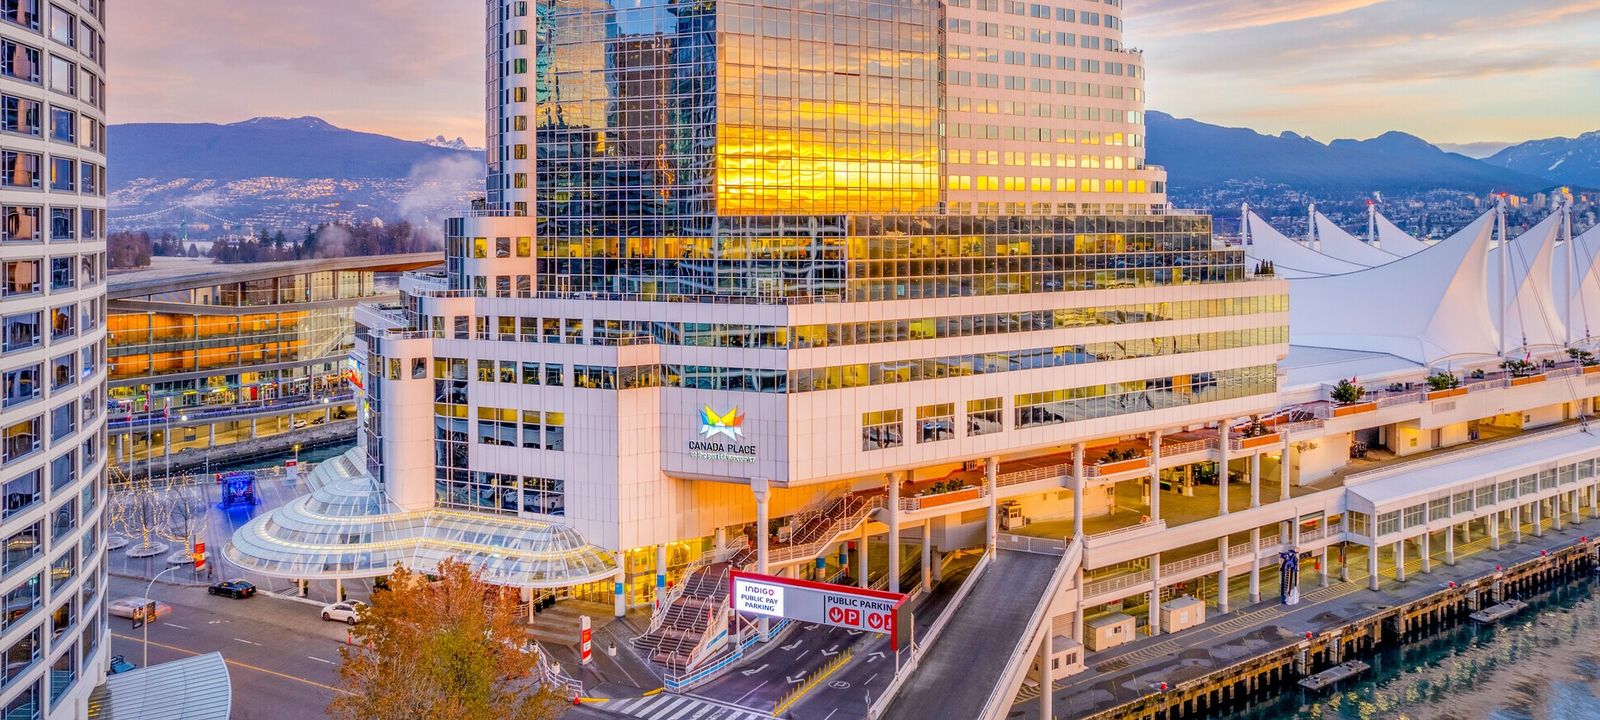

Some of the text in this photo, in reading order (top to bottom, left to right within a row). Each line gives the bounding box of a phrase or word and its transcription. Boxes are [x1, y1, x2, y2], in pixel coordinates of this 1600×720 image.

[689, 441, 756, 455] CANADA PLACE
[745, 585, 775, 596] INDIGO
[741, 594, 764, 603] PUBLIC
[827, 596, 893, 611] PUBLIC PARKIN
[745, 602, 775, 612] PARKING
[848, 611, 857, 623] P
